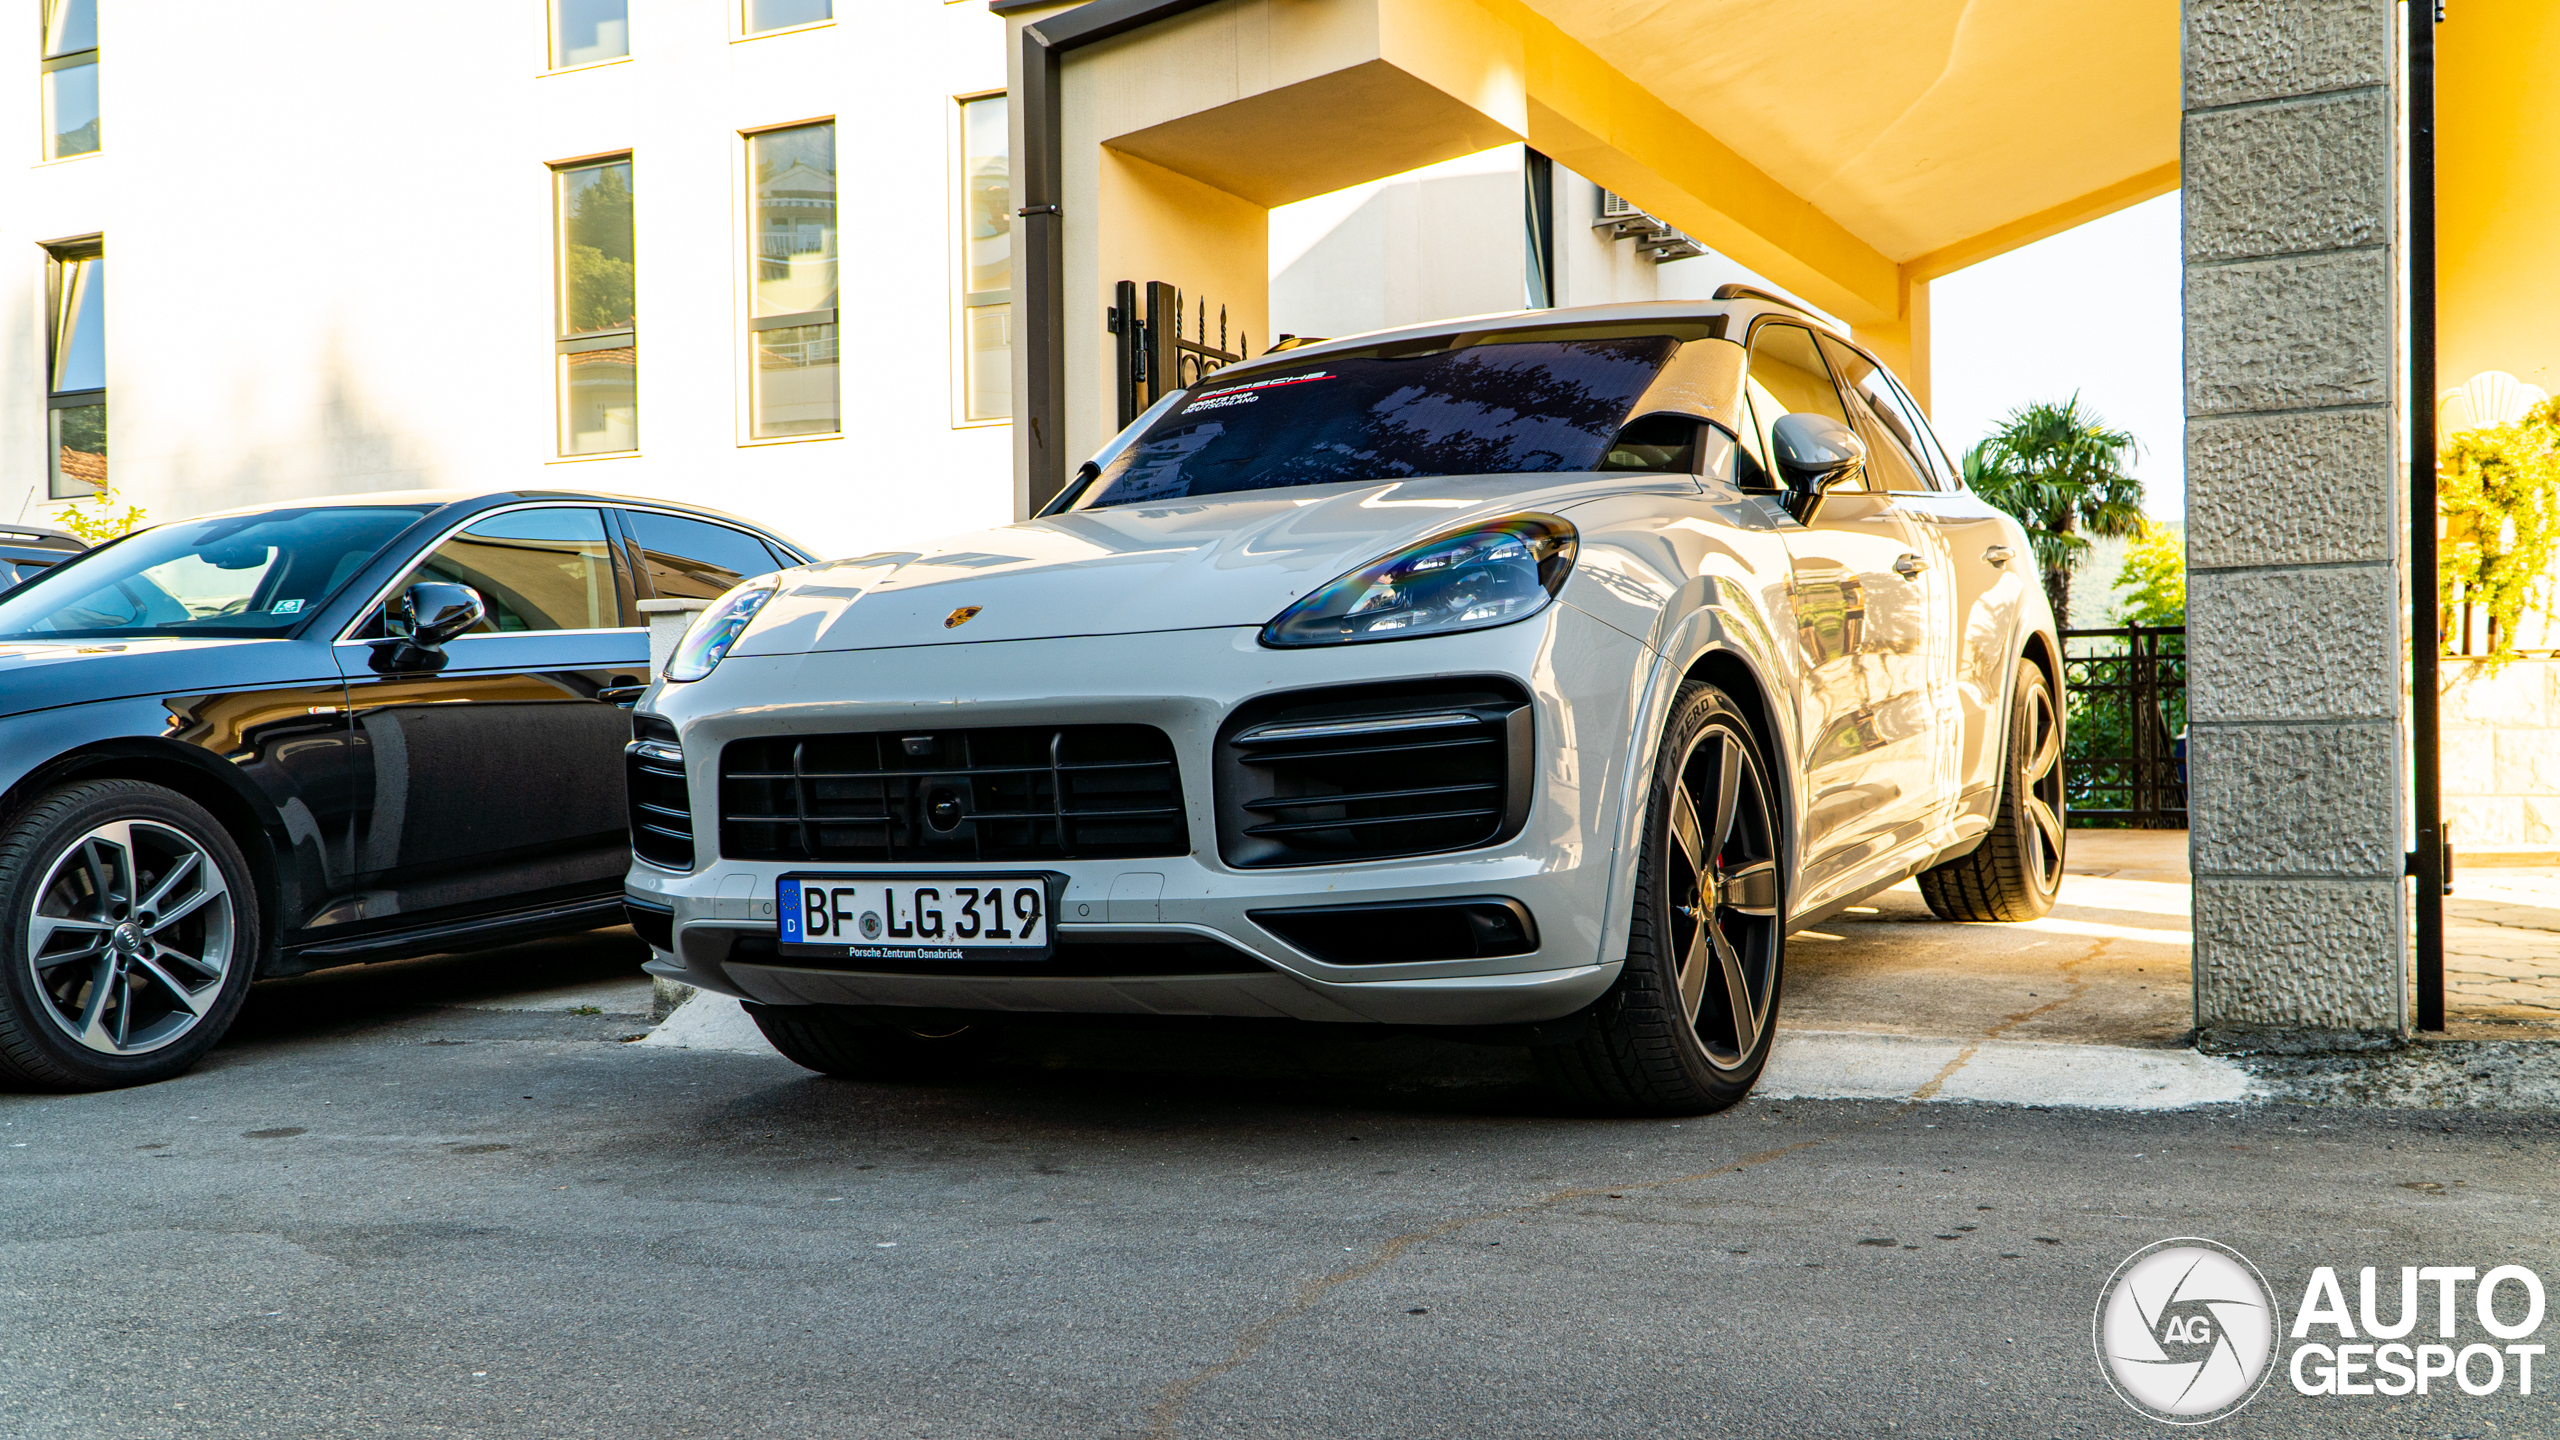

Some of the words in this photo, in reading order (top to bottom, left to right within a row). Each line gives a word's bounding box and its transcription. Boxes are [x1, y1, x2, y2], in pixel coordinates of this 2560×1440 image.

[1197, 371, 1327, 399] PORSCHE
[1181, 395, 1260, 415] DEUTSCHLAND
[1187, 395, 1230, 410] SPORTS
[1230, 391, 1254, 402] CUP
[1678, 698, 1709, 747] ZERO
[804, 887, 856, 937] BF
[885, 887, 944, 938] LG
[955, 887, 1041, 939] 319
[787, 918, 796, 933] D
[849, 946, 881, 957] Porsche
[882, 947, 917, 959] Zentrum
[917, 948, 964, 960] Osnabrück
